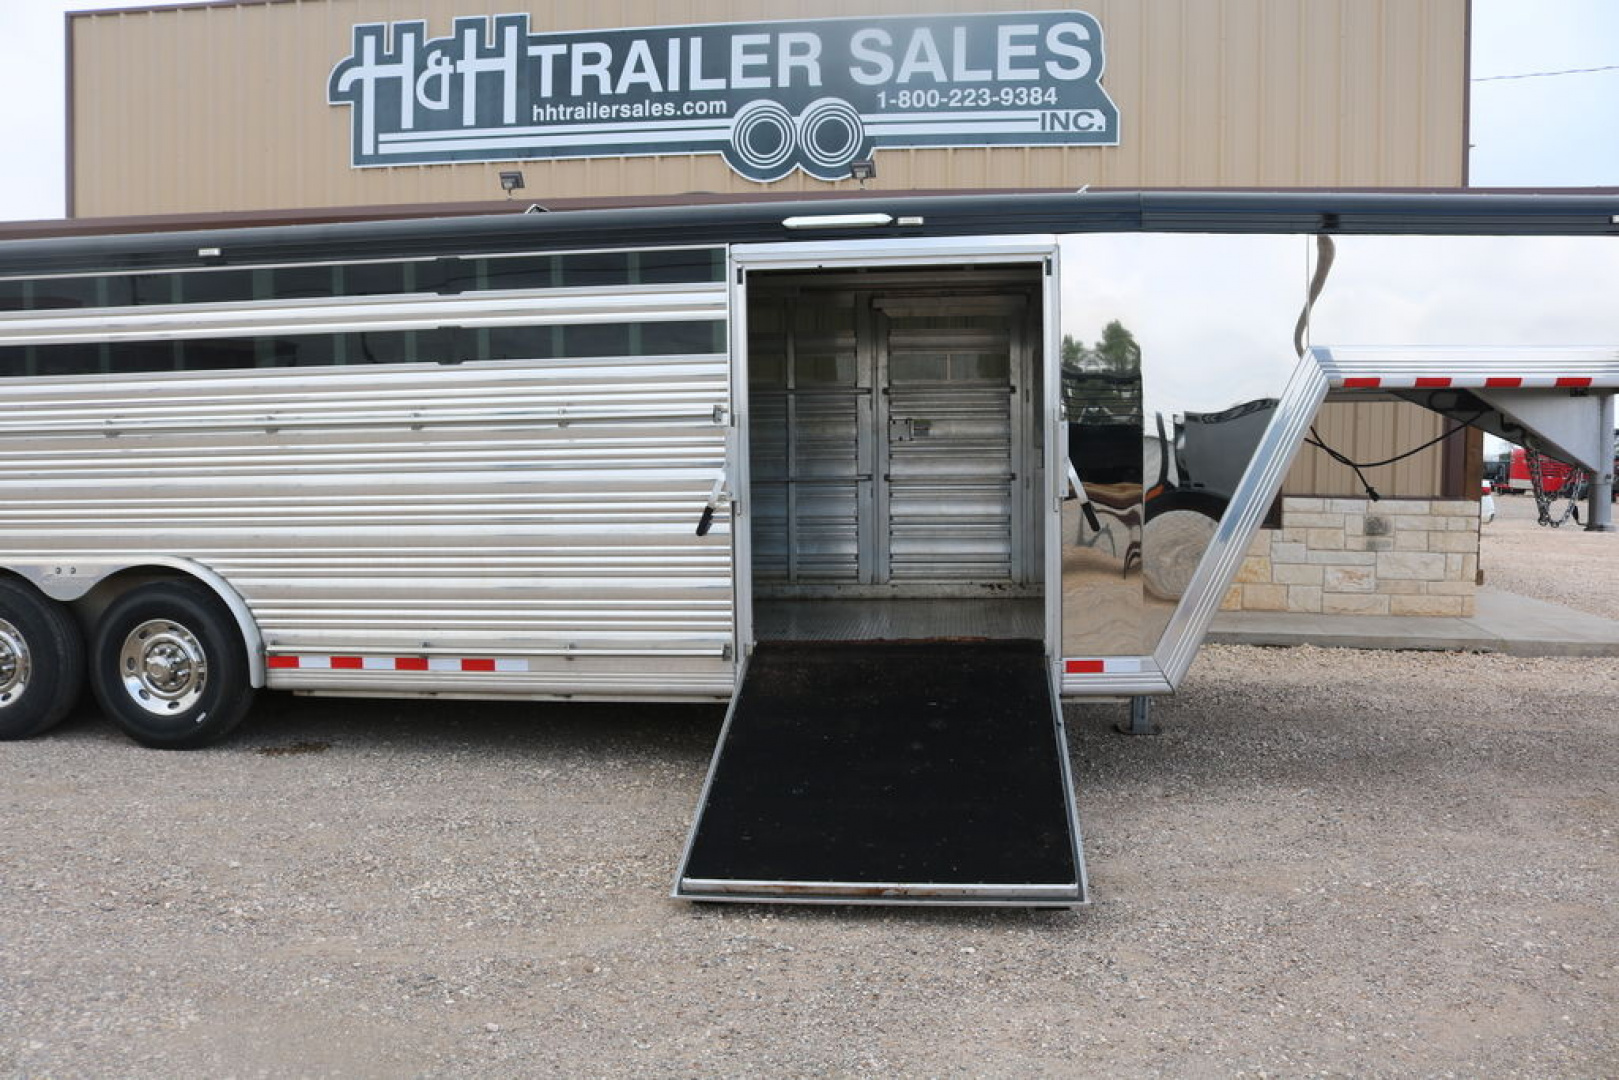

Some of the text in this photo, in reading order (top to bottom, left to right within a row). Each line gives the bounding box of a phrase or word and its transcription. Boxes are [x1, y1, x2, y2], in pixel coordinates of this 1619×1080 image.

[338, 22, 1092, 155] H&H TRAILER SALES
[877, 87, 1058, 109] 1-800-223-9384
[532, 99, 727, 122] hhtrailersales.com
[1039, 111, 1104, 132] INC.
